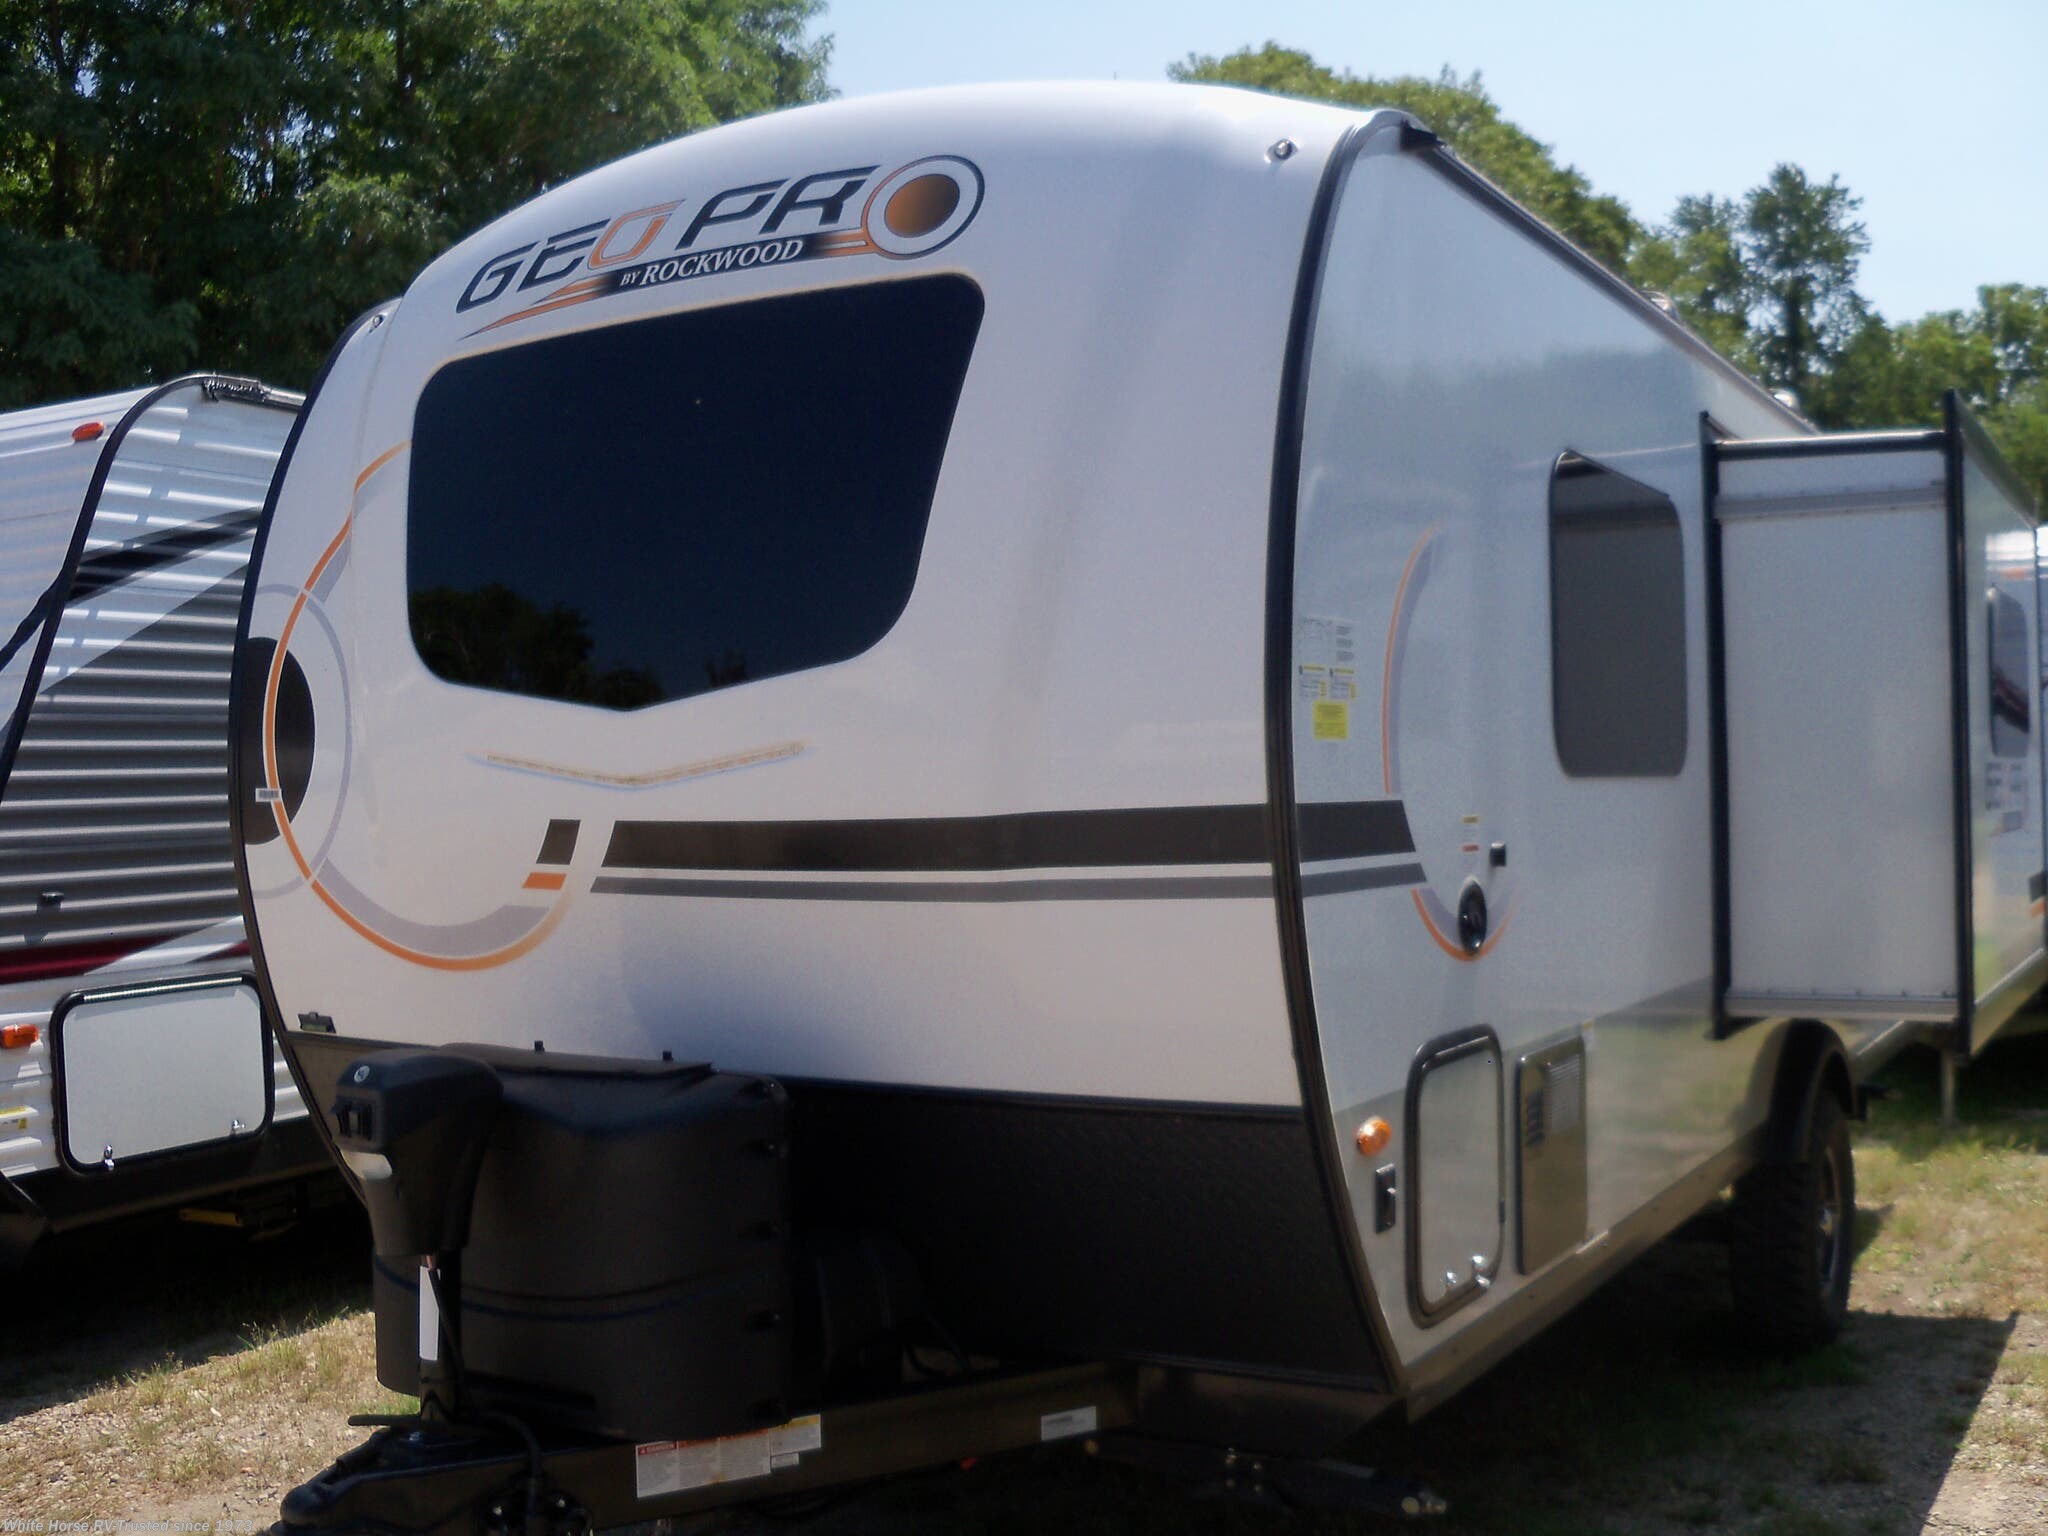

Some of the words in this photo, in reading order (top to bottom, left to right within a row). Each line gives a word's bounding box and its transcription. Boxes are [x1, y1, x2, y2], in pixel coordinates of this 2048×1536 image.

[456, 199, 686, 313] GEO
[674, 154, 985, 260] PRO
[620, 271, 641, 286] BY
[639, 239, 804, 286] ROCKWOOD
